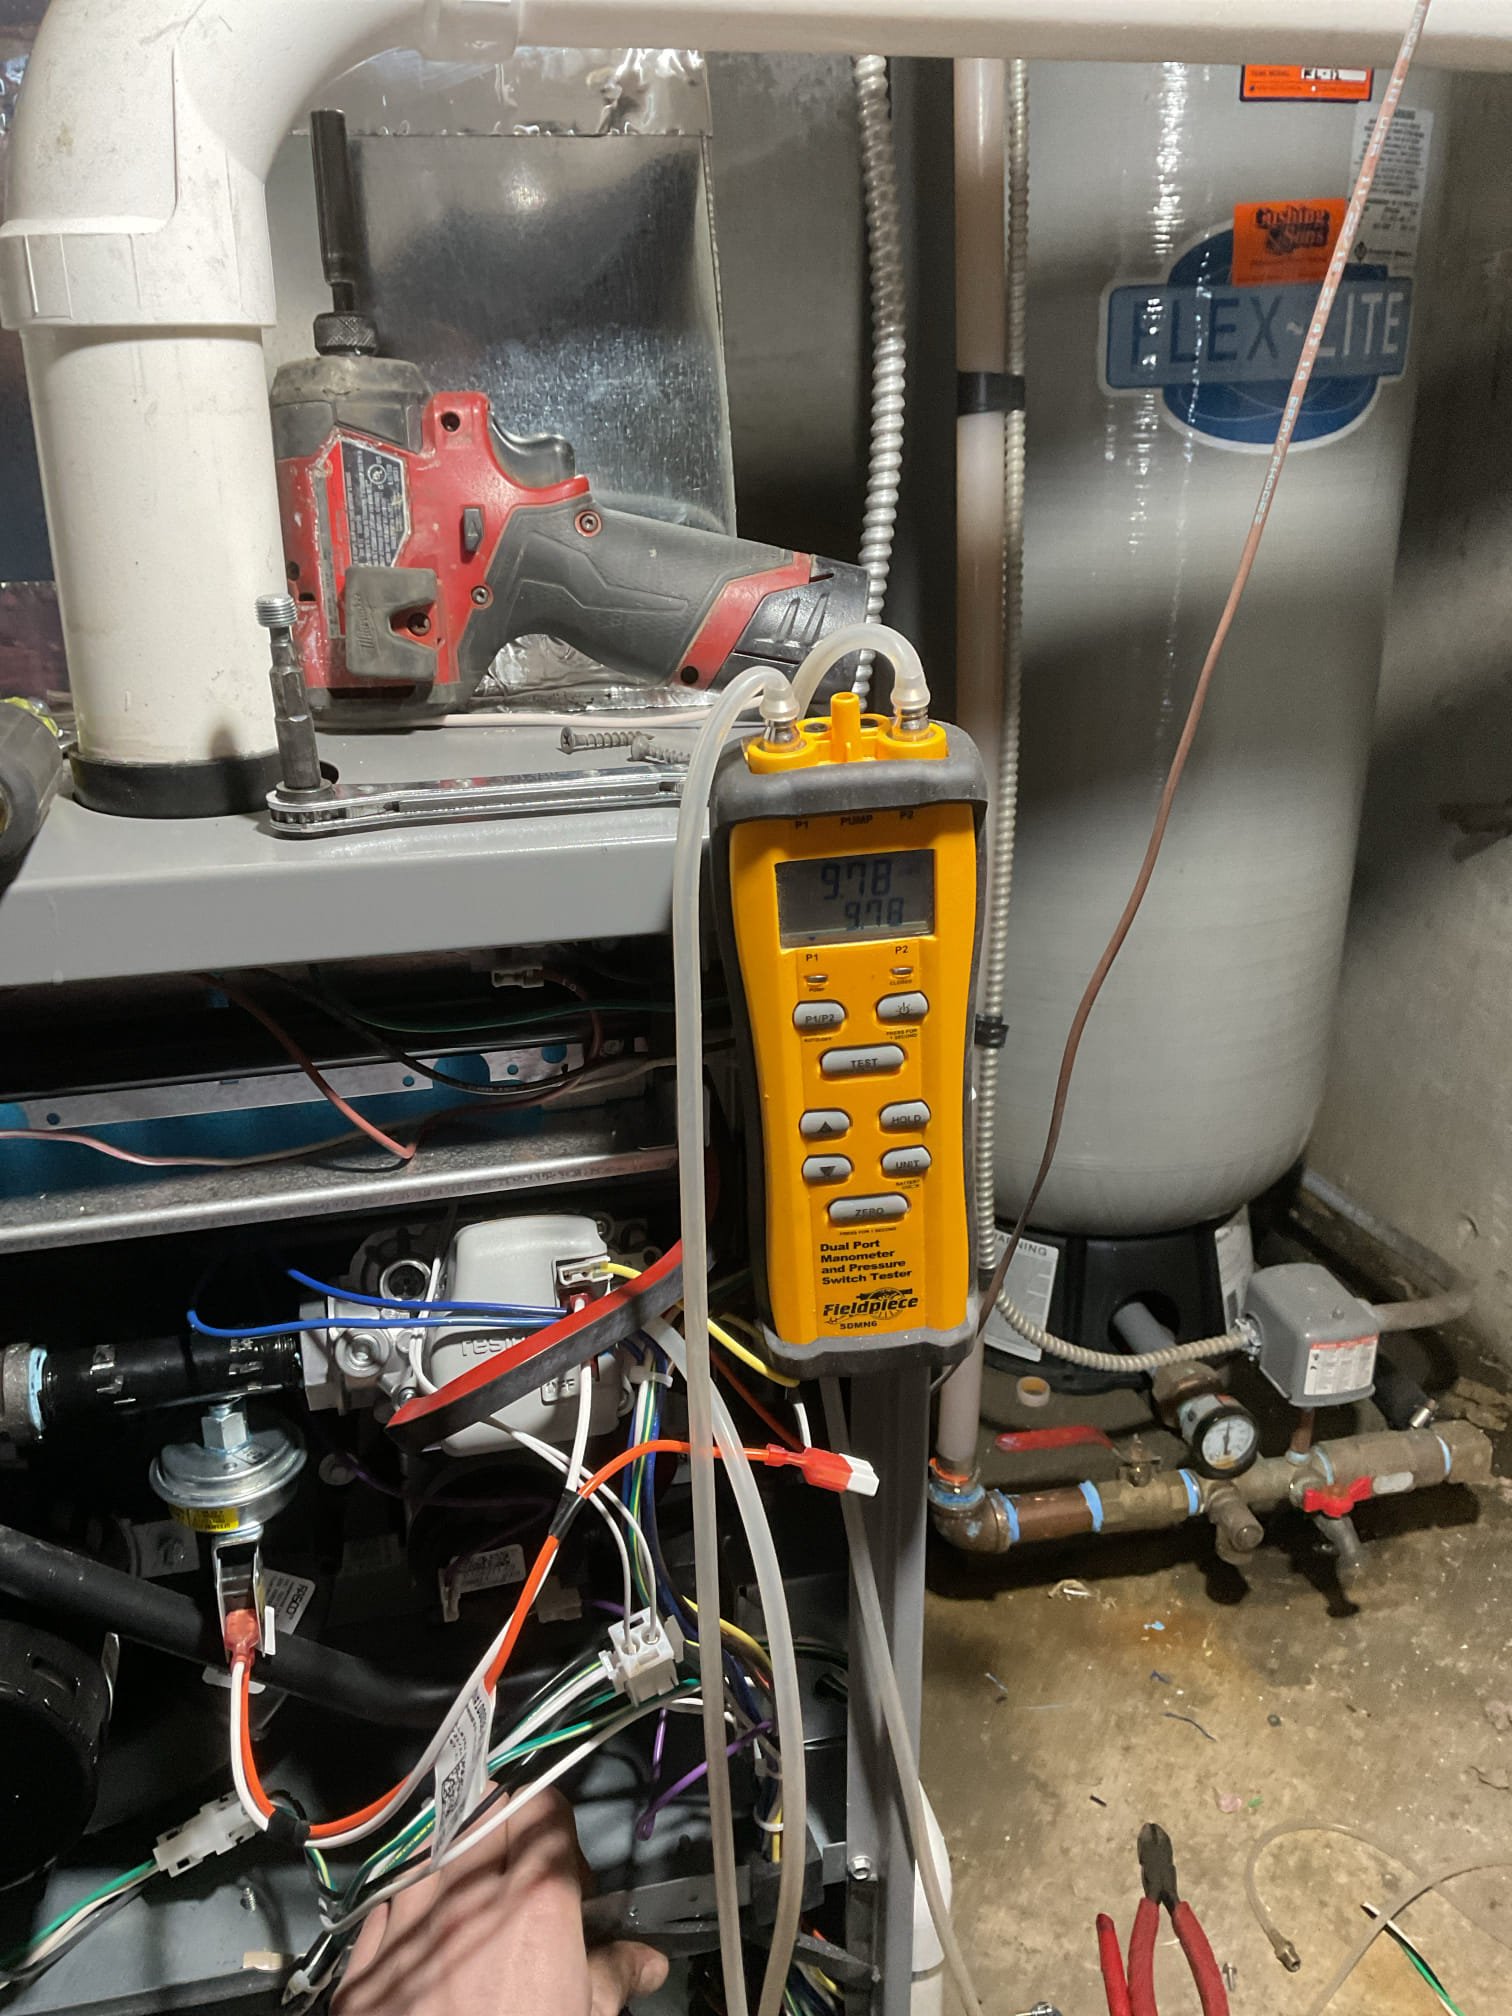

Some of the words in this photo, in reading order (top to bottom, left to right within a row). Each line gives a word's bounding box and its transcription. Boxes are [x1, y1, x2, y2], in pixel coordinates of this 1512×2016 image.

[840, 815, 873, 826] PUMP
[895, 946, 908, 954] P2
[806, 954, 818, 962] P1
[805, 1014, 835, 1024] P1/P2
[850, 1057, 878, 1068] TEST
[892, 1114, 922, 1125] HOLD
[895, 1159, 920, 1169] UNIT
[855, 1208, 884, 1217] ZERO
[820, 1242, 849, 1252] Dual
[853, 1240, 880, 1250] Port
[994, 1234, 1047, 1257] ANING
[820, 1249, 895, 1264] Manometer
[821, 1264, 846, 1274] and
[849, 1258, 906, 1273] Pressure
[822, 1273, 867, 1285] Switch
[871, 1268, 912, 1282] Tester
[823, 1294, 919, 1319] Fieldpiece
[840, 1320, 878, 1330] SDMN6
